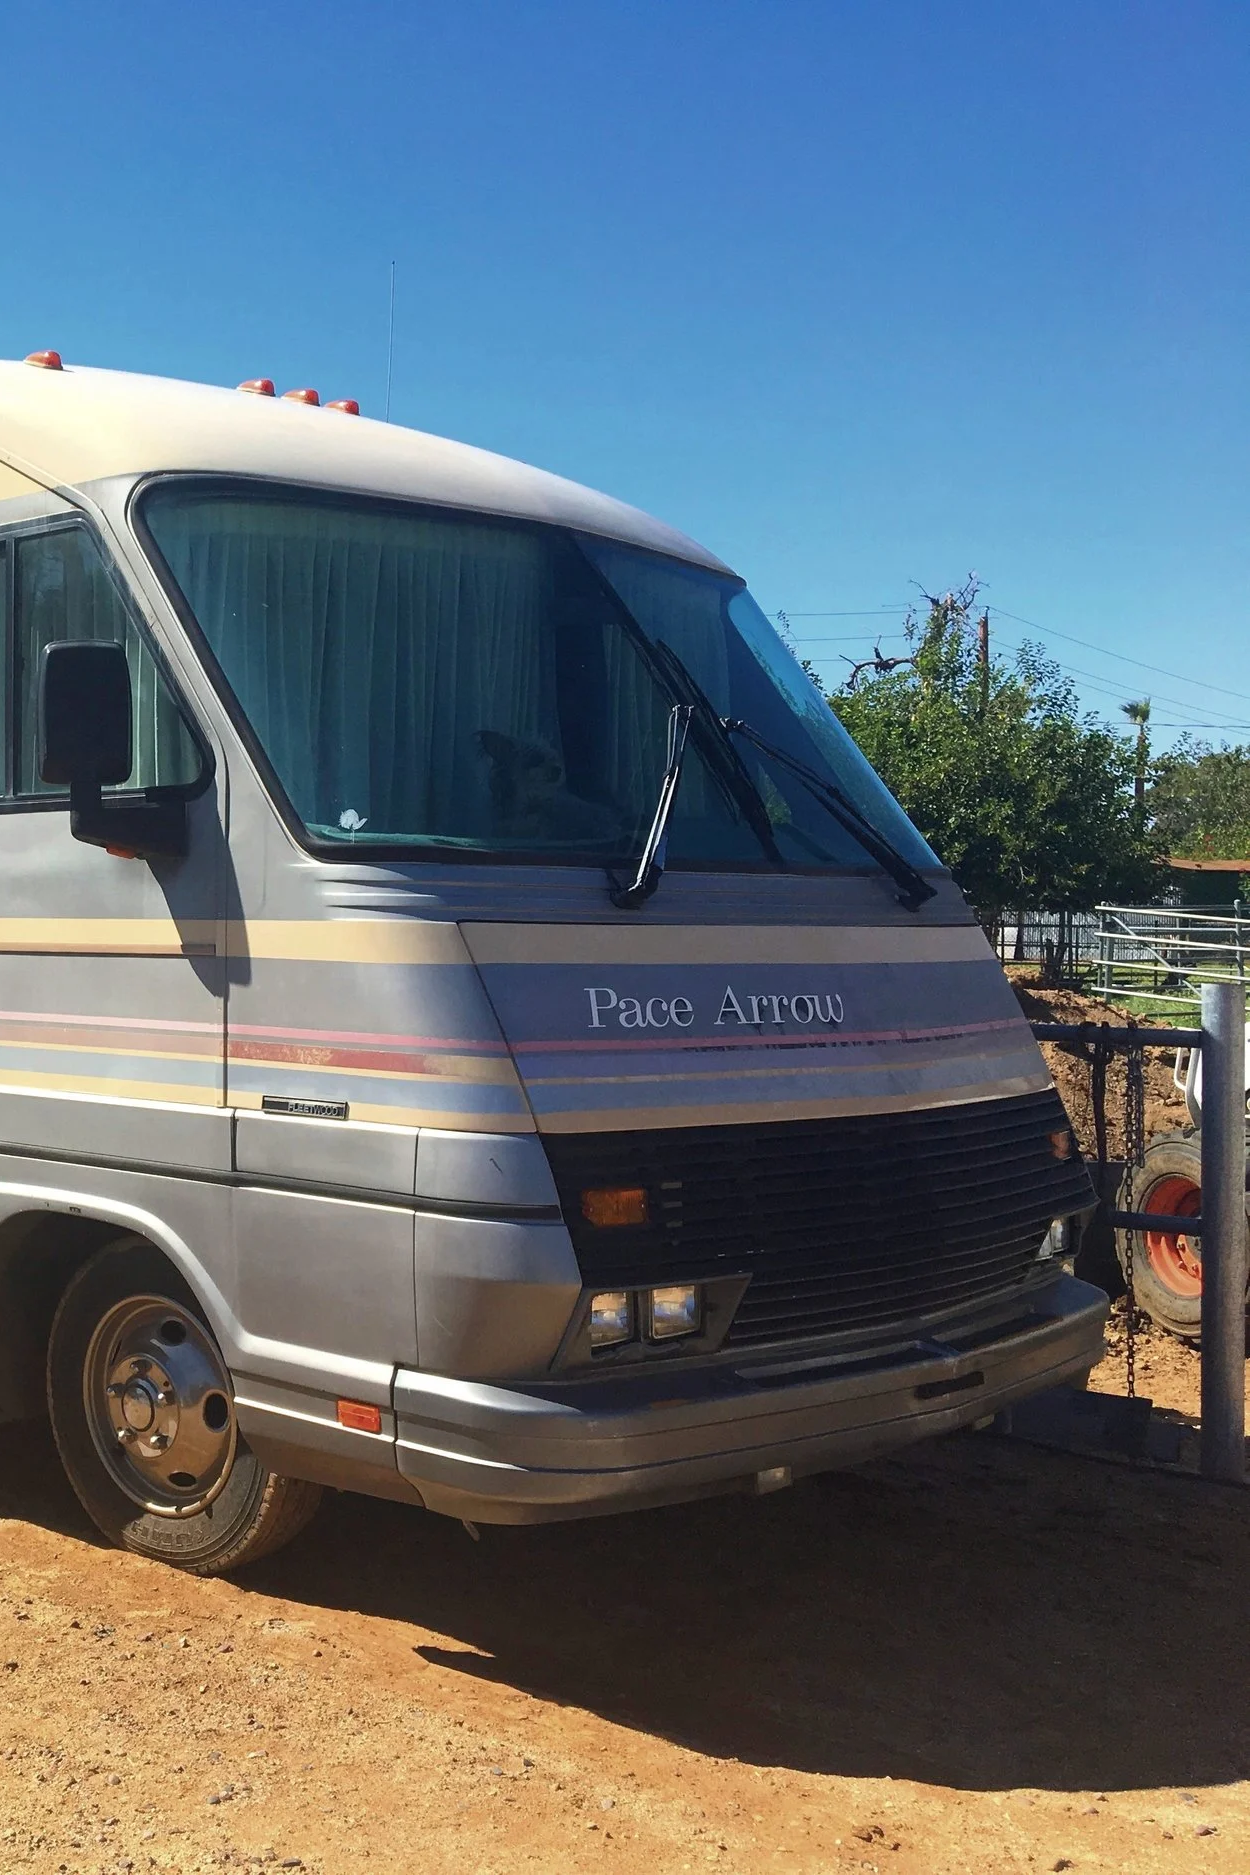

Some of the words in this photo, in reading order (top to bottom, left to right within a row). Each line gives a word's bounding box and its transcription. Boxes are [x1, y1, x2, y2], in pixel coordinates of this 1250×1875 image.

[584, 987, 695, 1028] Pace
[713, 985, 845, 1025] Arrow
[288, 1102, 338, 1116] FLEETWOOD
